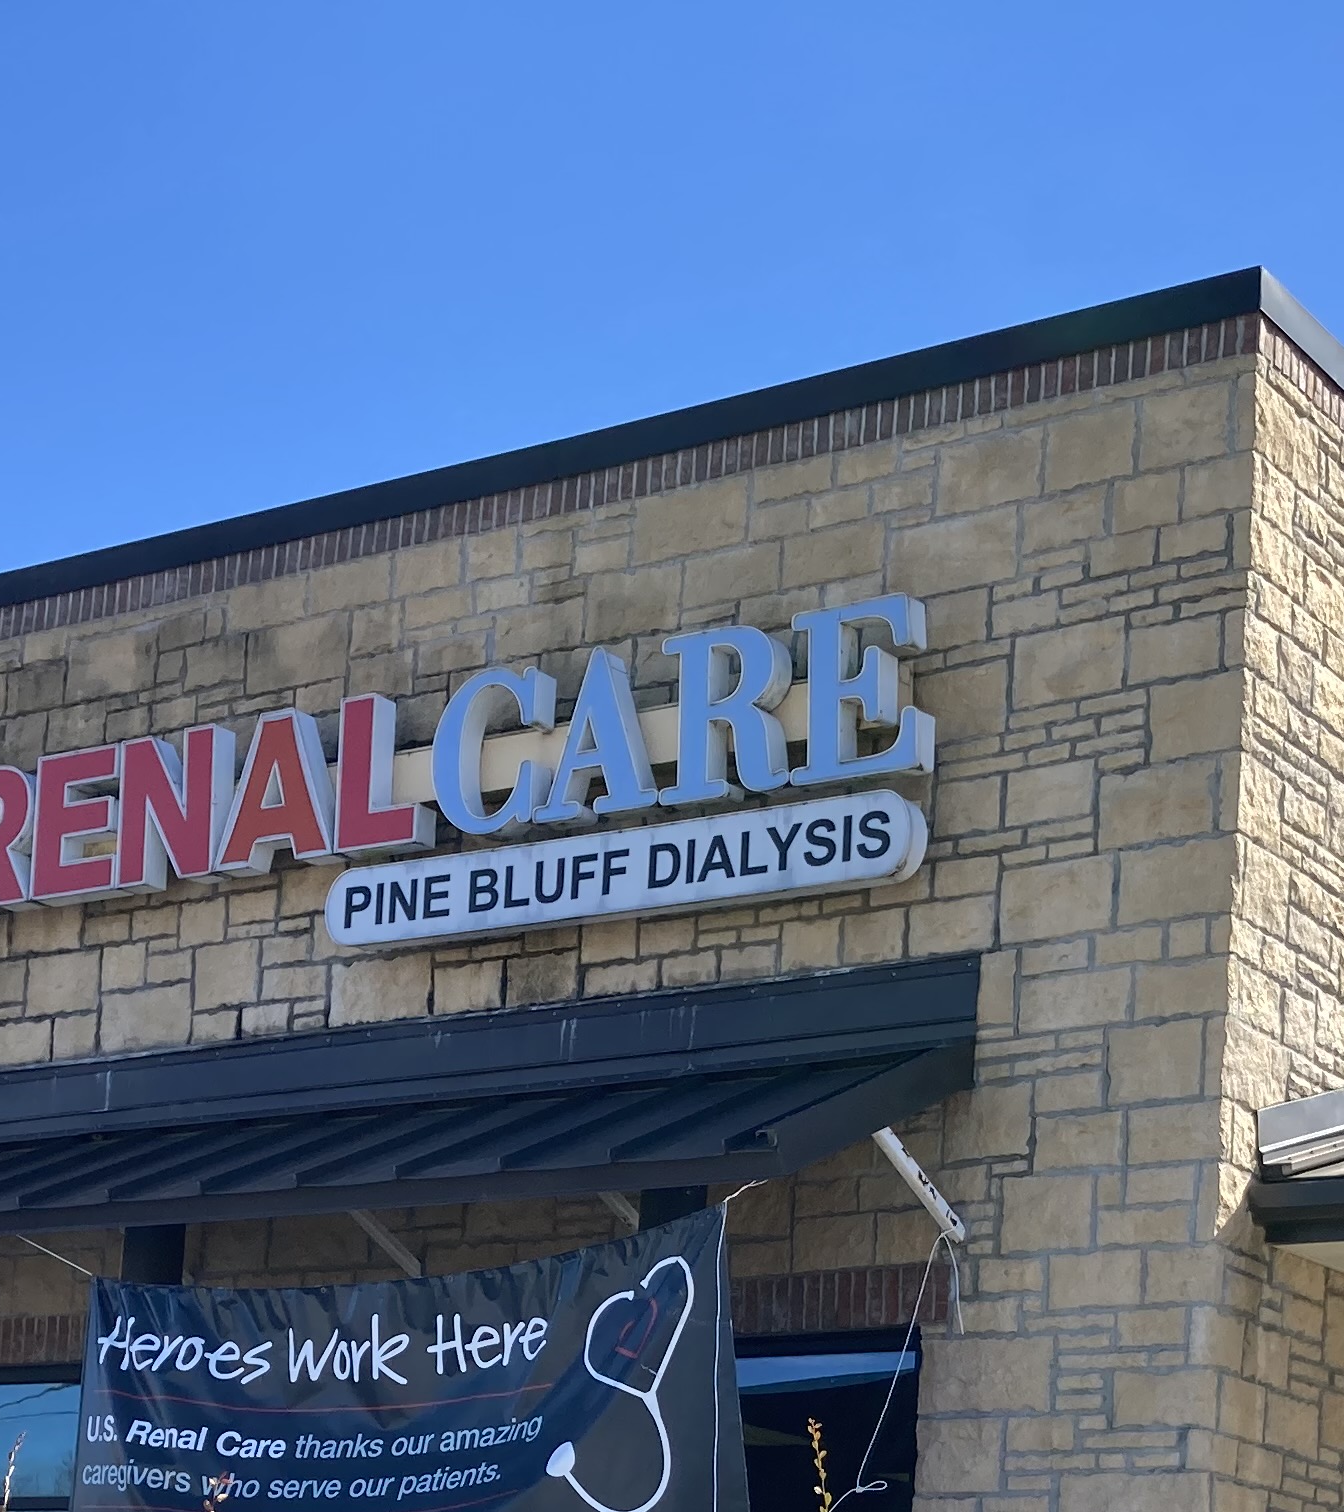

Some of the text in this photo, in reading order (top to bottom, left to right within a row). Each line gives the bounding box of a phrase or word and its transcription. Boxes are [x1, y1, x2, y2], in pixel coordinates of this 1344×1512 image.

[431, 592, 928, 835] CARE
[343, 809, 894, 929] PINE BLUFF DIALYSIS
[97, 1313, 548, 1385] Heroes Work Here
[87, 1414, 543, 1459] U.S. Renal Care thanks our amazing
[82, 1458, 502, 1501] caregivers who serve our patients.
